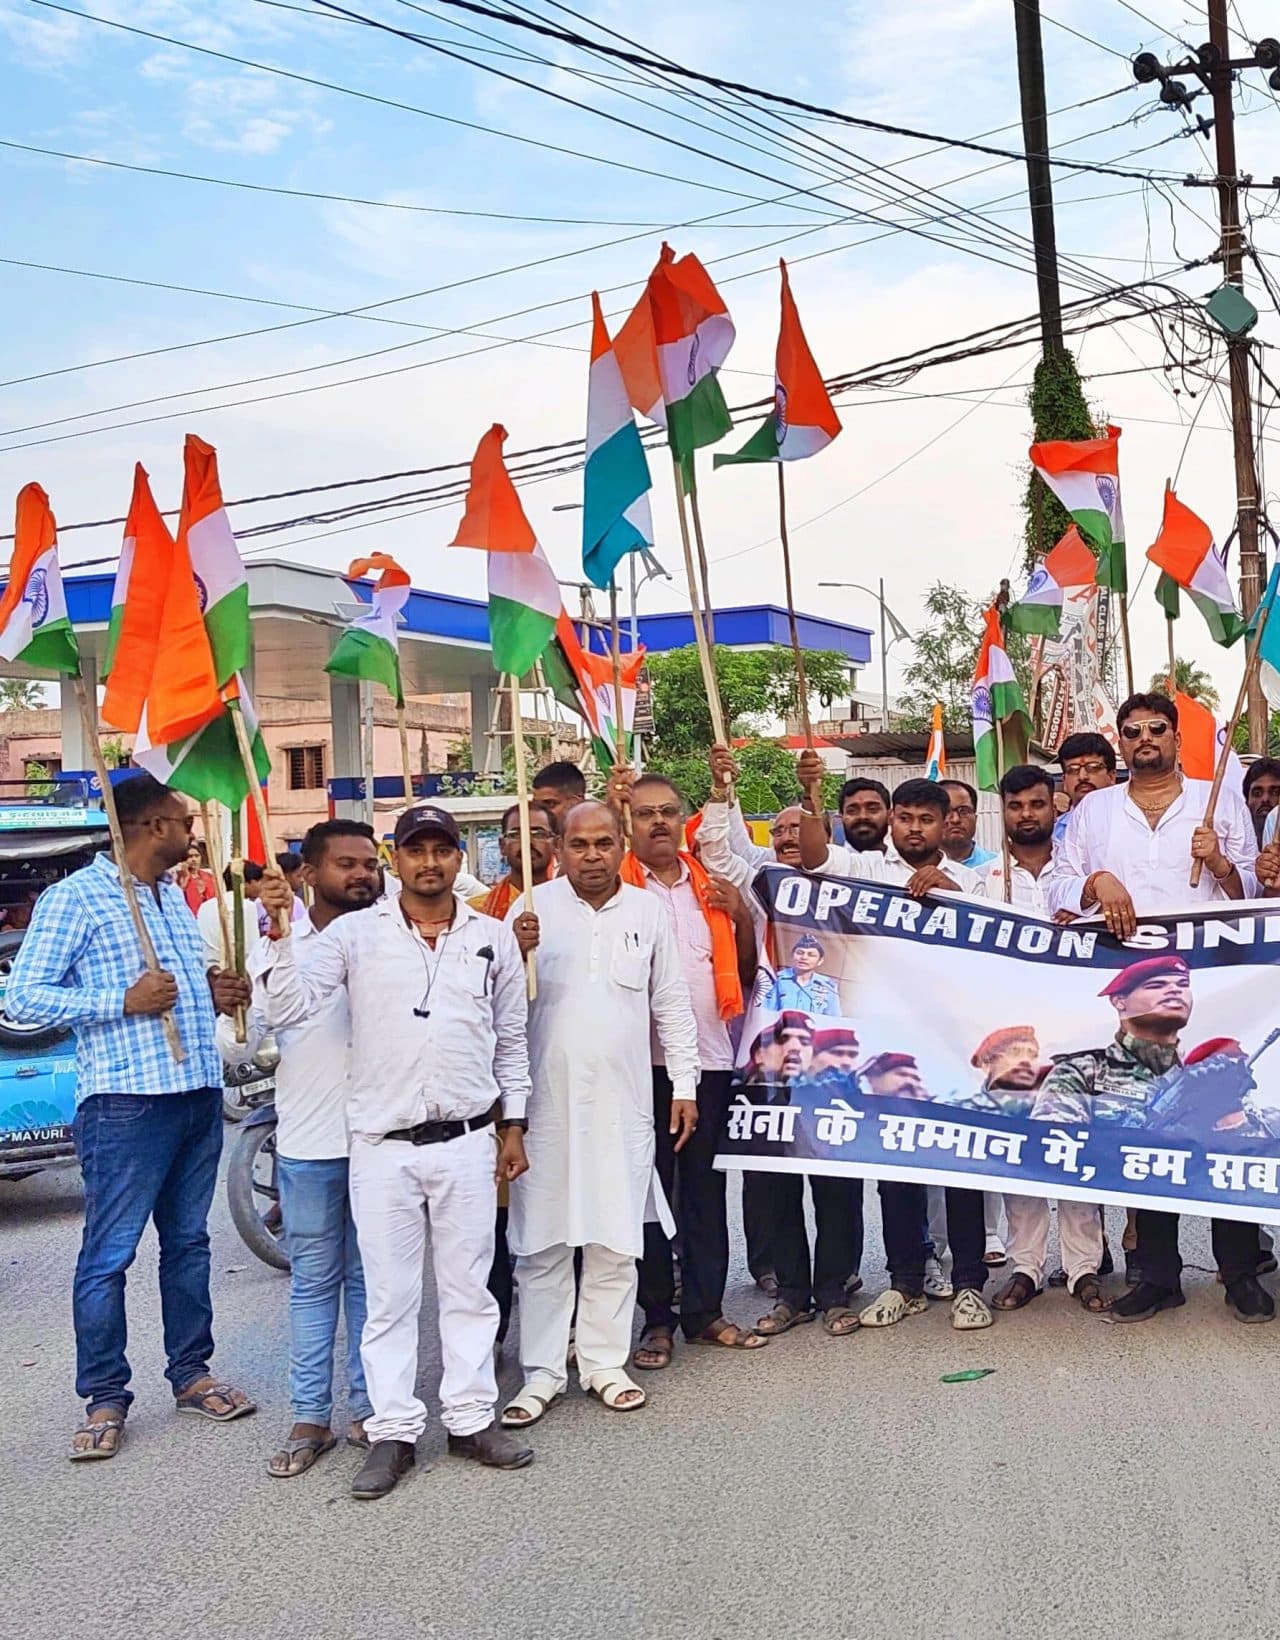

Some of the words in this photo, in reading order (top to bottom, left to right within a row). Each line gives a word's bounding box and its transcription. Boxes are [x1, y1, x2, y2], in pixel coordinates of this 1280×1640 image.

[774, 876, 1099, 959] OPERATION
[11, 1129, 64, 1142] MAYURI
[726, 1096, 798, 1142] सेना
[815, 1098, 864, 1146] के
[878, 1112, 1026, 1165] सम्मान
[1042, 1130, 1097, 1182] में,
[1120, 1145, 1192, 1185] हम
